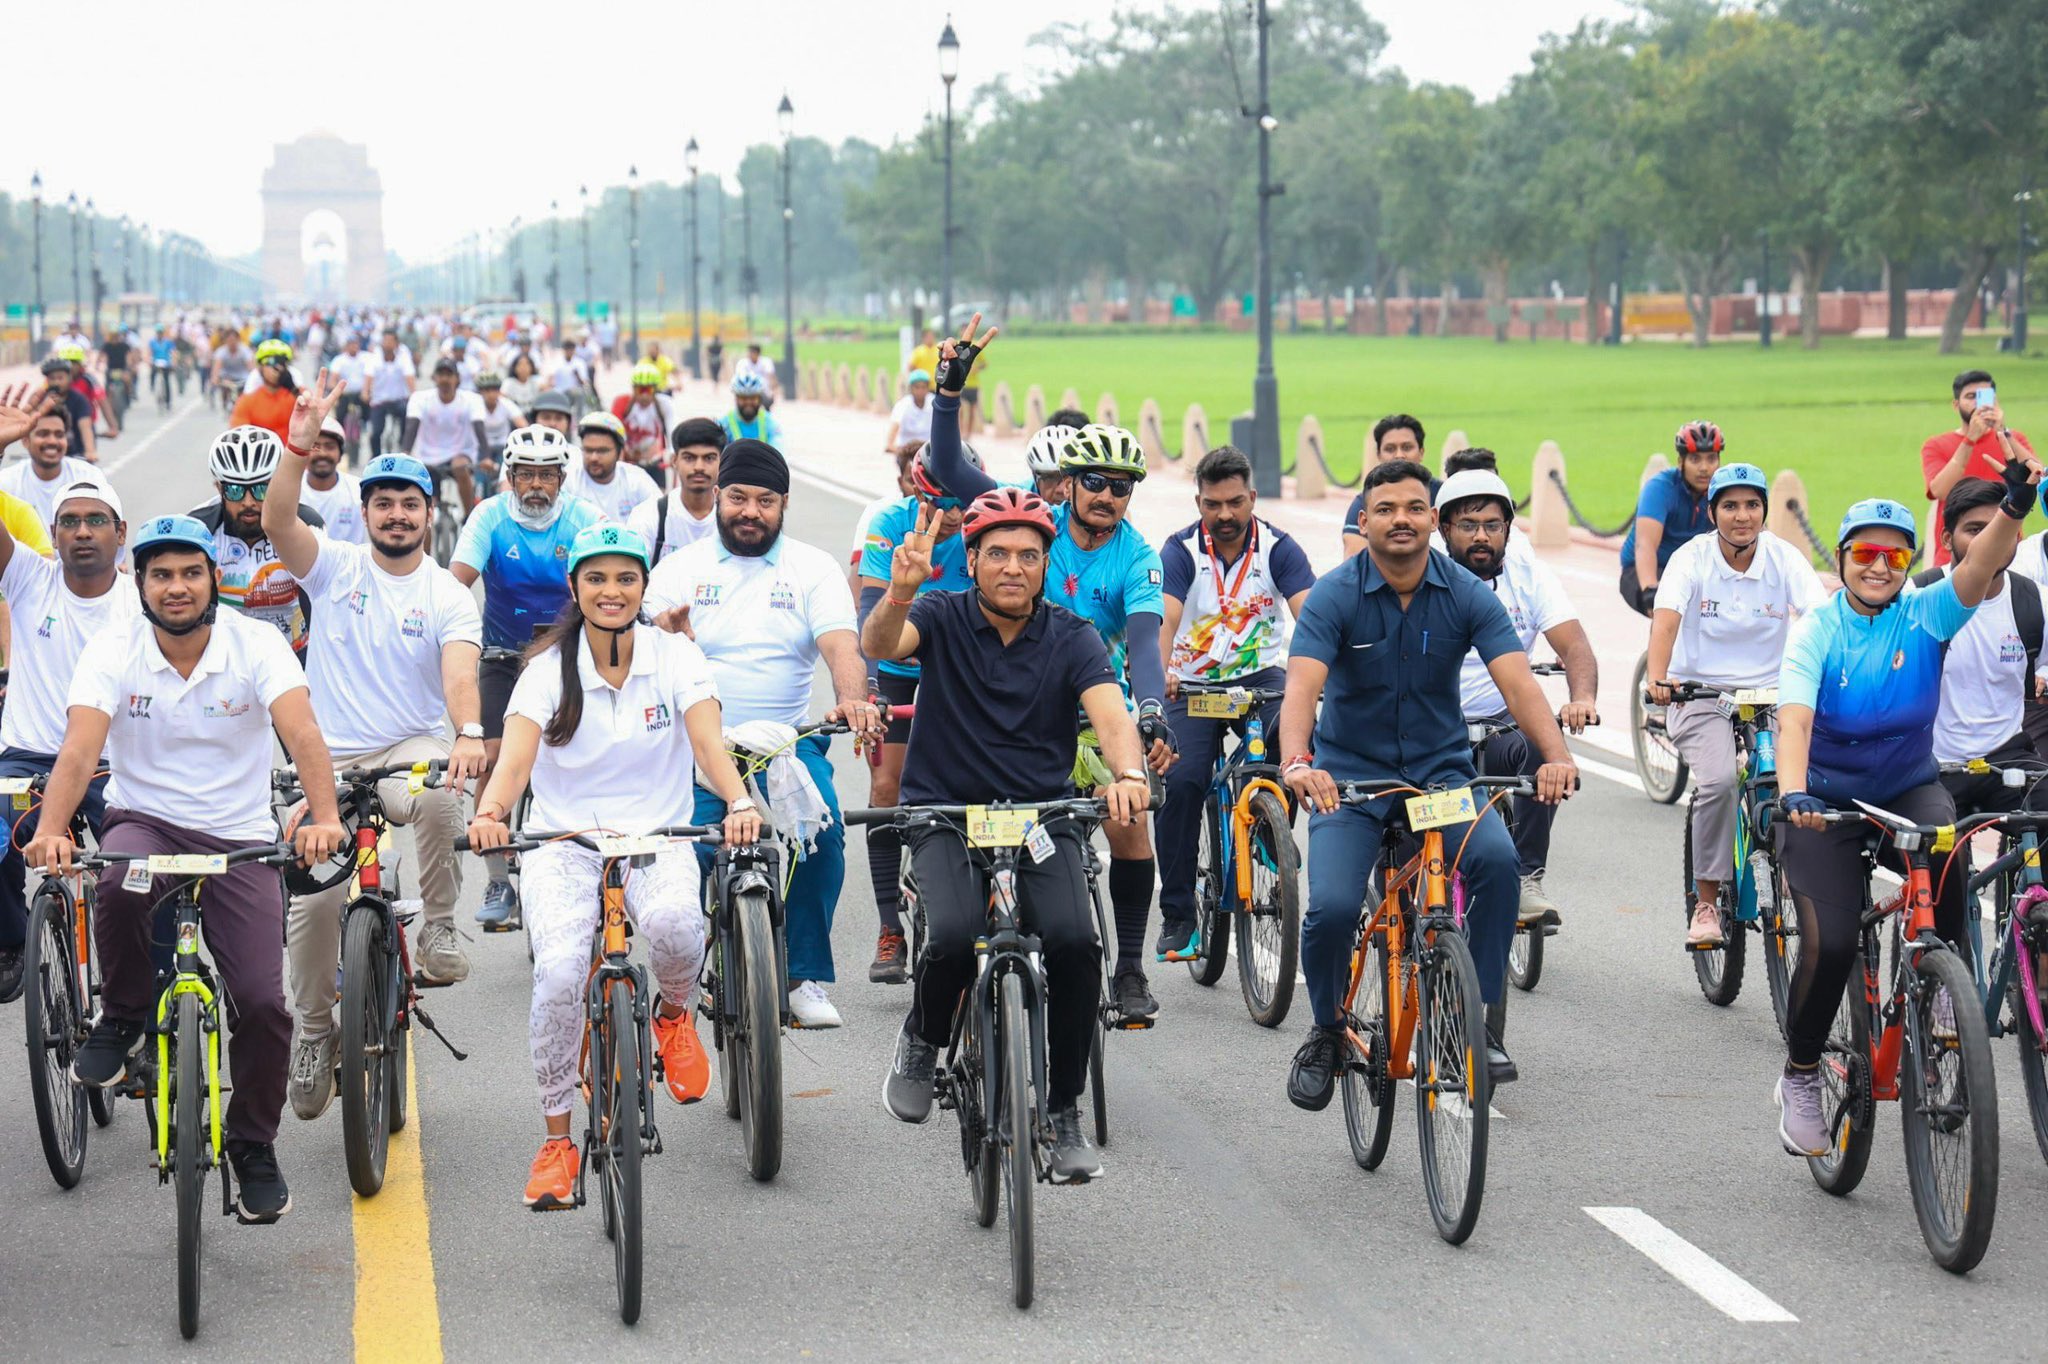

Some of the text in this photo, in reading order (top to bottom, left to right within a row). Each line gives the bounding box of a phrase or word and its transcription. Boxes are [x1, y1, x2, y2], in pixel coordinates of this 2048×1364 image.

[694, 598, 721, 606] INDIA
[128, 709, 151, 719] INDIA
[646, 719, 671, 732] INDIA
[1416, 815, 1438, 824] INDIA
[128, 877, 150, 885] INDIA
